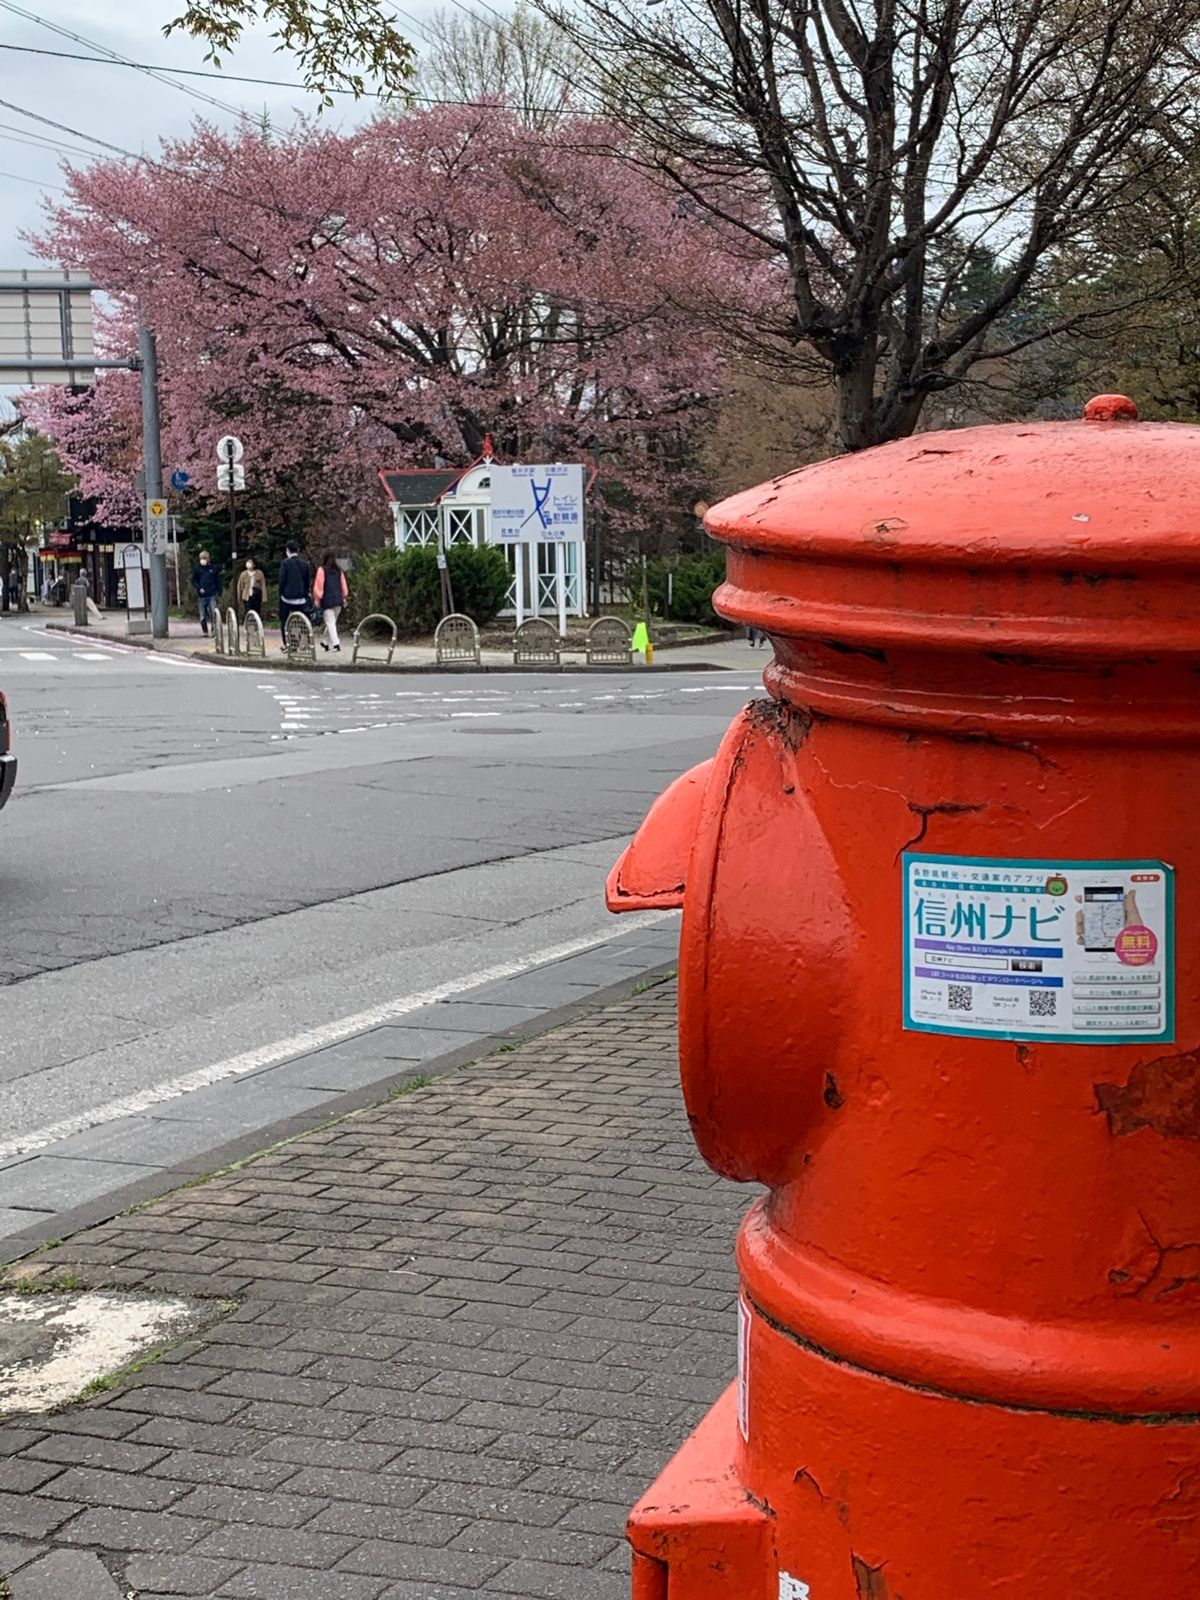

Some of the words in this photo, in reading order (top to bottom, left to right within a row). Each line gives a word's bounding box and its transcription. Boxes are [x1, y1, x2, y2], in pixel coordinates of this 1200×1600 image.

[553, 495, 578, 503] トイレ
[913, 898, 1066, 942] 信州ナビ
[1122, 935, 1150, 948] 無料
